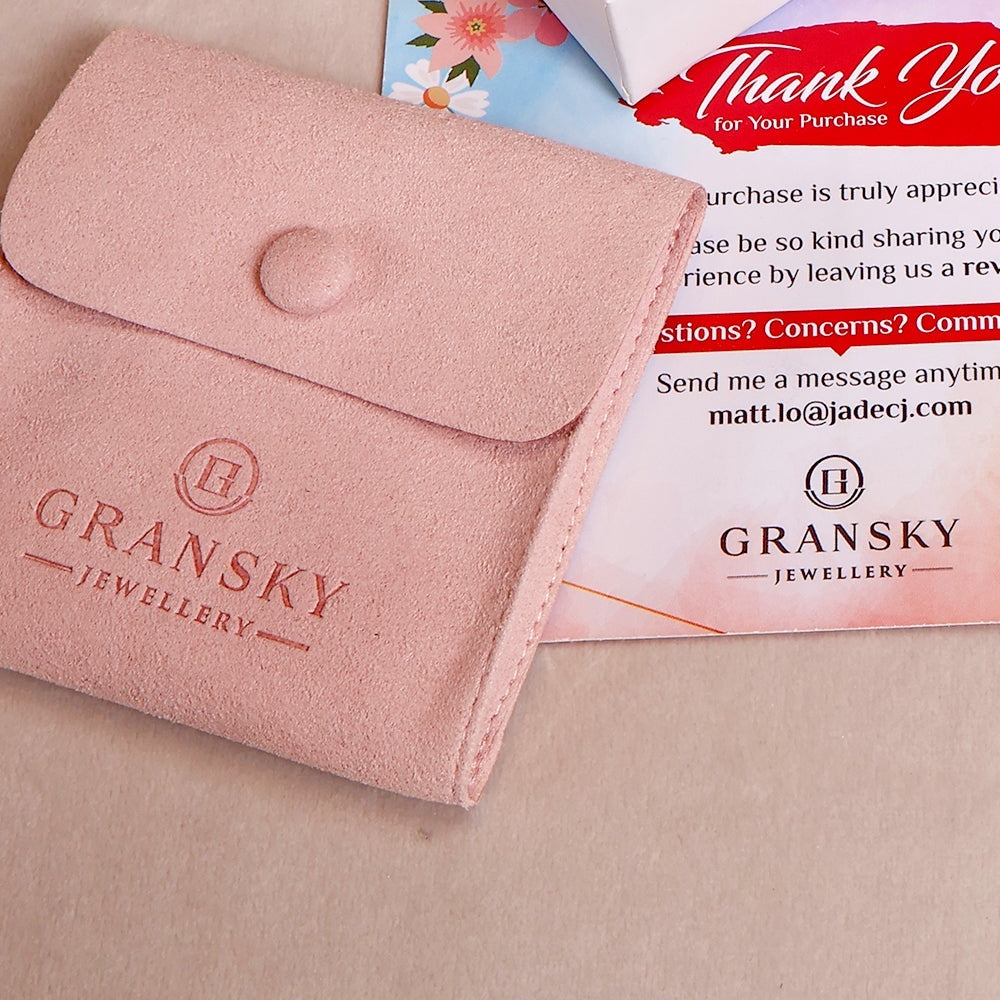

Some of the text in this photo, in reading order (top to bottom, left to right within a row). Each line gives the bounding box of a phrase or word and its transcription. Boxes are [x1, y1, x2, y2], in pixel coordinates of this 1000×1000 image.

[679, 43, 888, 120] Thank
[715, 113, 887, 131] for Your Purchase
[707, 186, 802, 205] urchase
[812, 185, 830, 201] is
[840, 181, 897, 204] truly
[690, 239, 730, 255] ase
[738, 234, 766, 252] be
[776, 237, 803, 251] so
[812, 230, 863, 249] kind
[874, 229, 965, 249] sharing
[684, 269, 760, 286] rience
[770, 265, 799, 288] by
[808, 262, 896, 284] leaving
[904, 264, 932, 278] us
[942, 263, 953, 276] a
[661, 318, 757, 343] stions?
[764, 312, 907, 338] Concerns?
[657, 372, 718, 393] Send
[729, 375, 765, 390] me
[775, 375, 787, 389] a
[797, 370, 906, 390] message
[709, 399, 971, 426] matt.lo@jadecj.com
[721, 519, 959, 556] GRANSKY
[35, 488, 349, 618] GRANSKY
[775, 565, 906, 585] JEWELLERY
[76, 564, 254, 638] JEWELLERY
